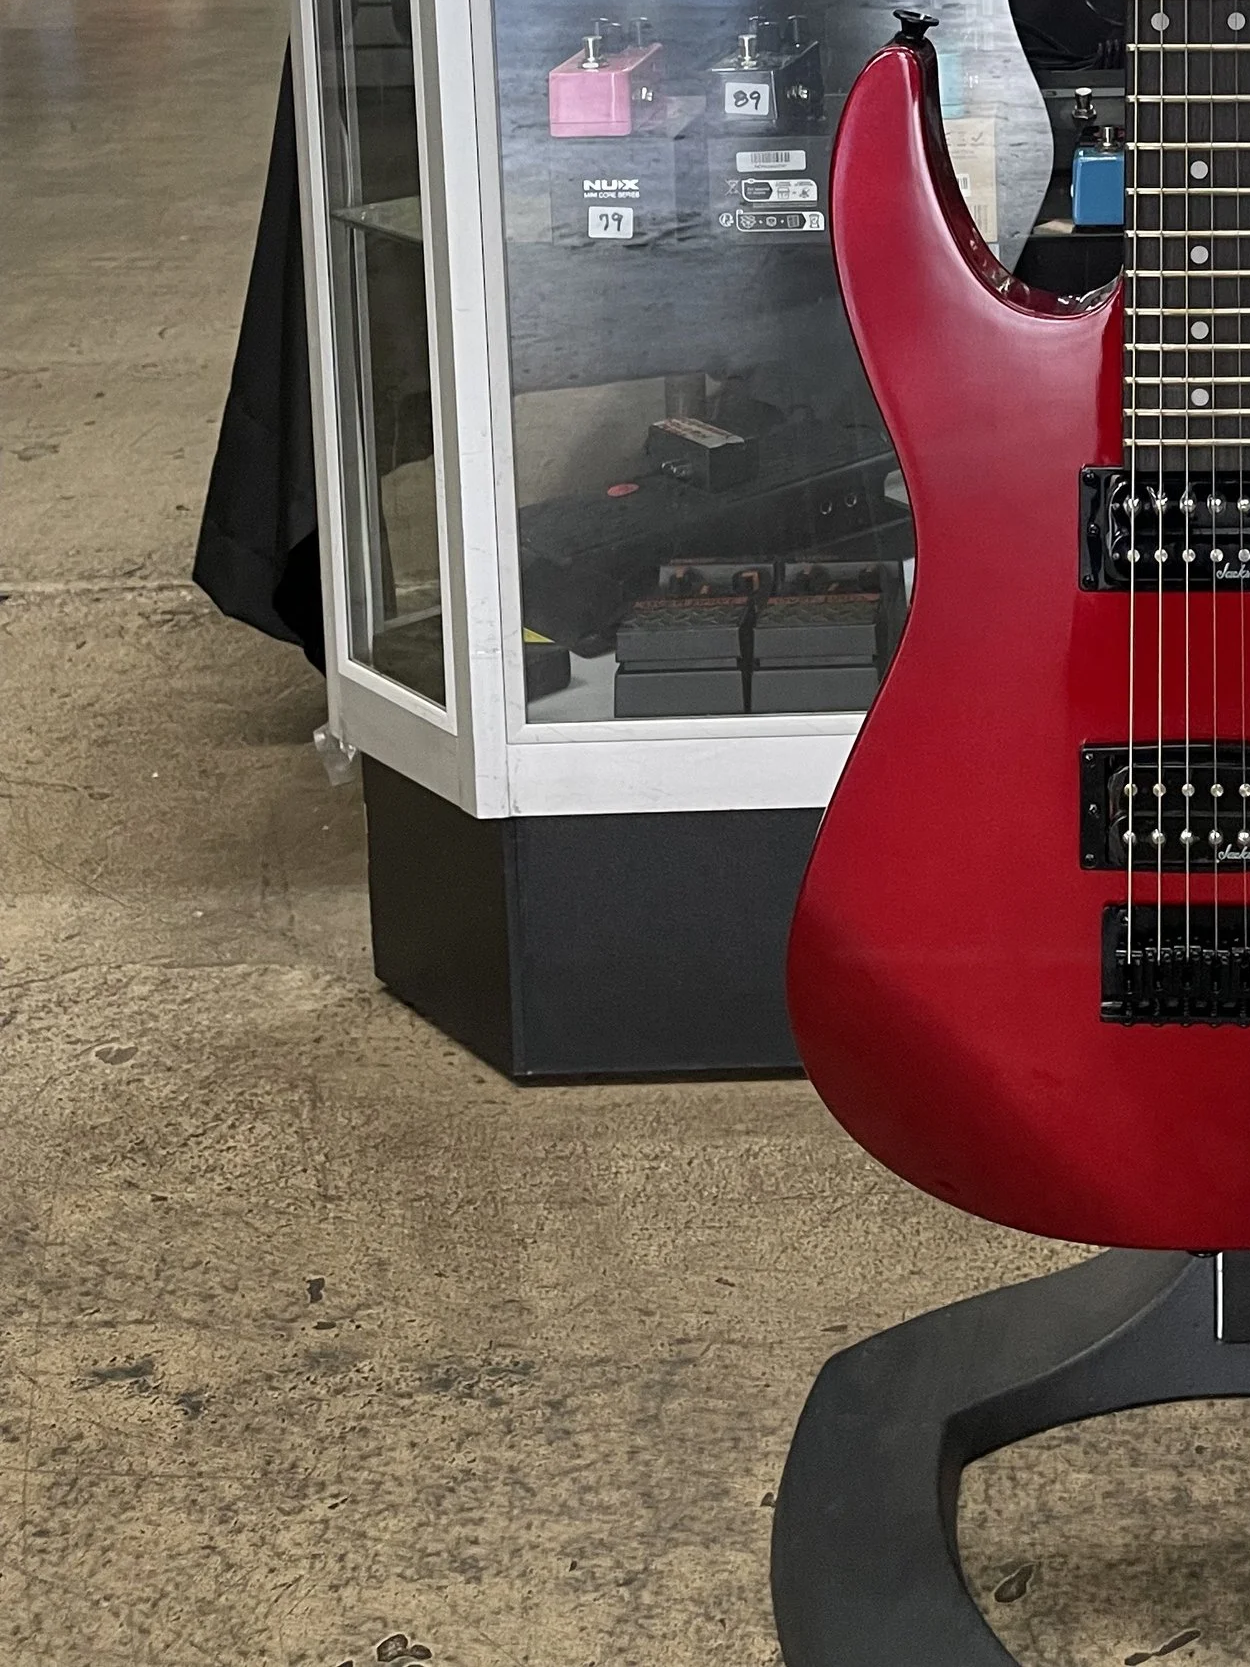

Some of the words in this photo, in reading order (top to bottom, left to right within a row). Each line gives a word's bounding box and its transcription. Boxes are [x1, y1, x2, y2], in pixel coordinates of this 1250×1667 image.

[732, 90, 762, 110] 89
[583, 179, 640, 191] NUX
[599, 212, 624, 232] 79
